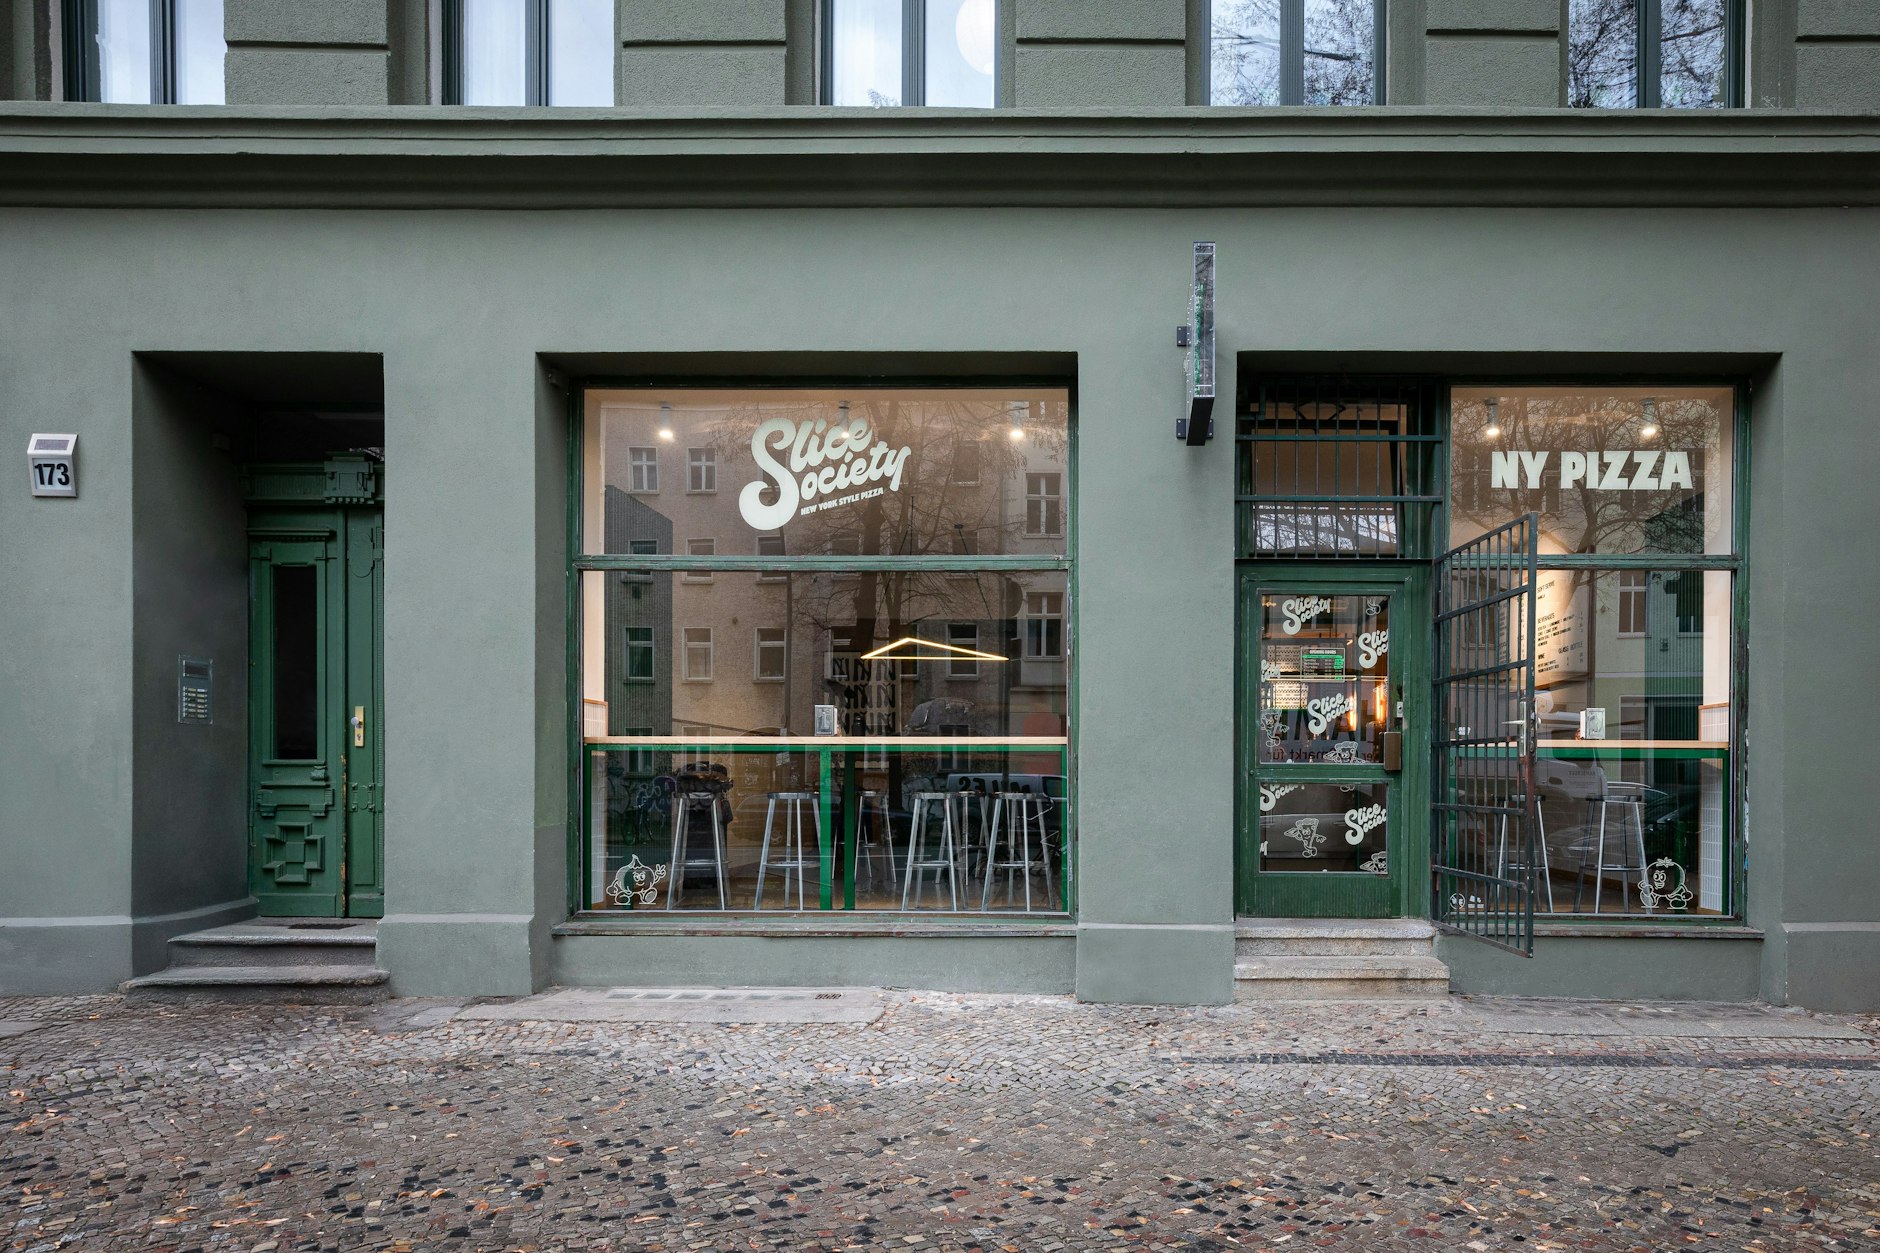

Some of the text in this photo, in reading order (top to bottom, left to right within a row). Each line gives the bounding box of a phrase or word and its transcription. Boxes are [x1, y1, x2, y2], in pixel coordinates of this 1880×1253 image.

[34, 462, 70, 486] 173
[739, 417, 873, 531] Slice
[1490, 450, 1653, 490] NY PIZZA
[800, 487, 884, 516] NEW YORK STYLE PIZZA
[1308, 693, 1344, 735] Slice
[1344, 803, 1381, 845] Slice
